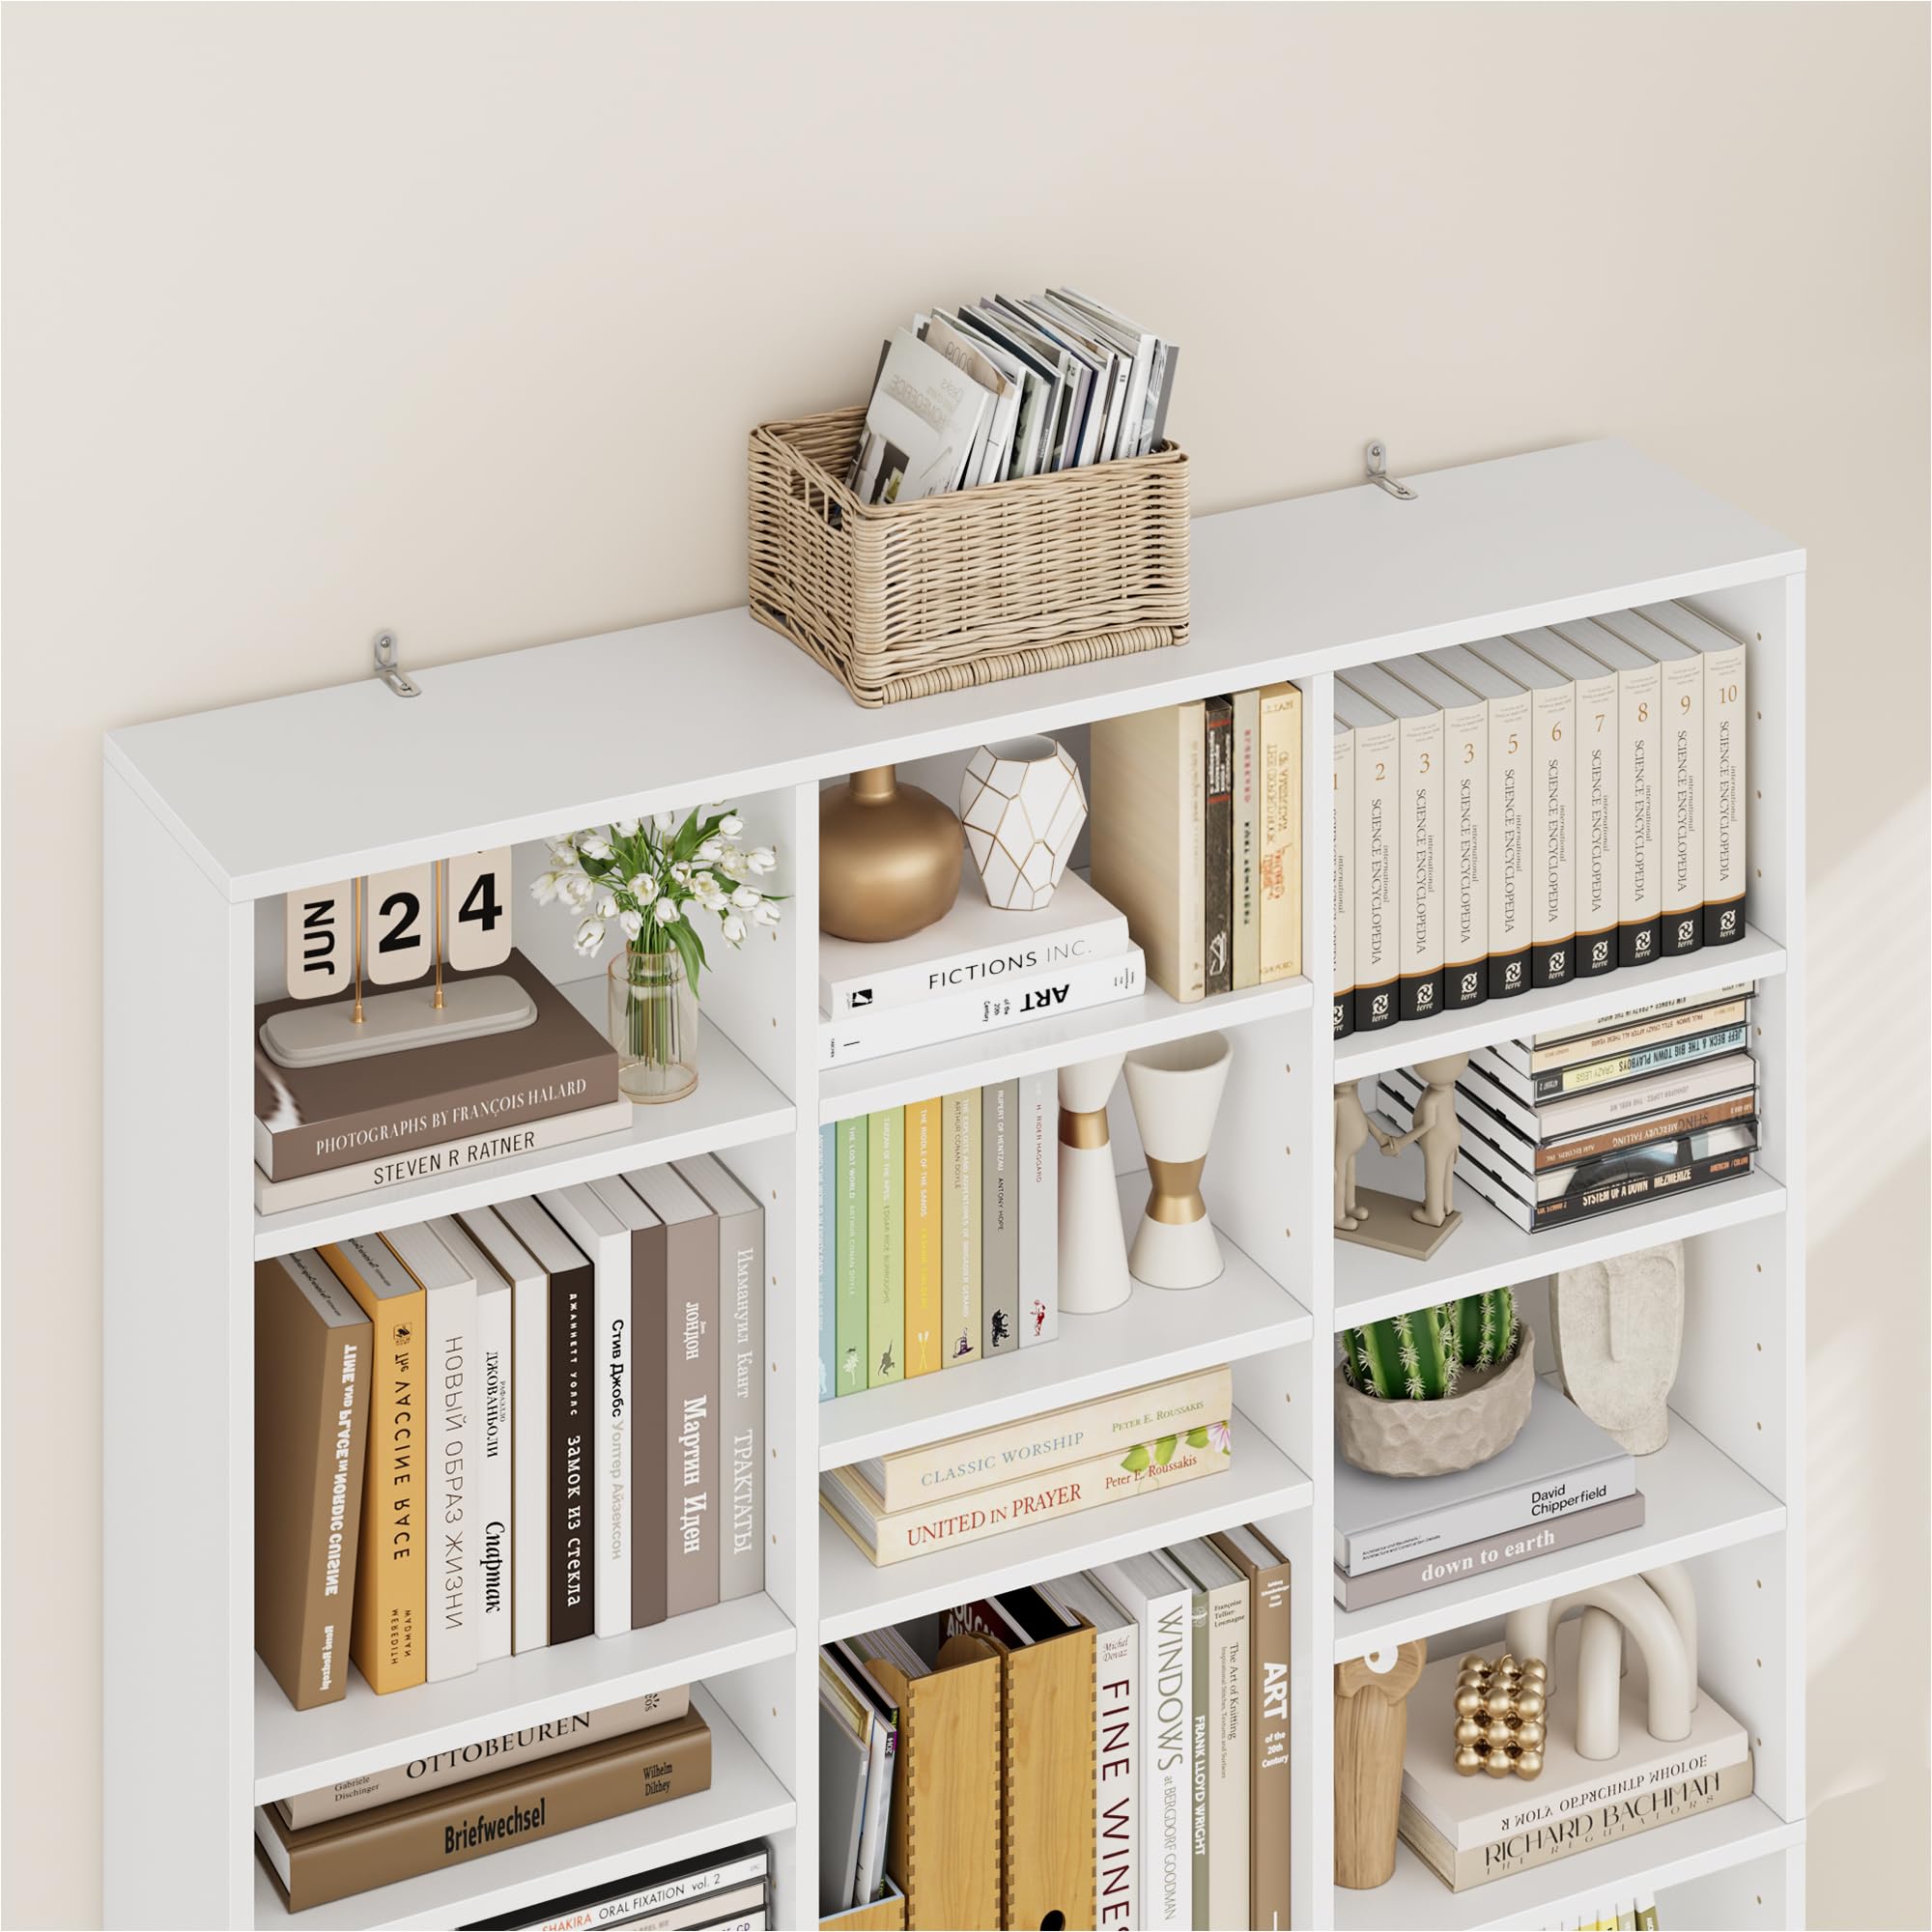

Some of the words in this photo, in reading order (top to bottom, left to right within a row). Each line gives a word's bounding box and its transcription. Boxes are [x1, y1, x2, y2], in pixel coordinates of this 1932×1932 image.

[1637, 702, 1648, 723] 8
[1681, 695, 1691, 716] 9
[1719, 684, 1737, 704] 10
[1508, 733, 1519, 754] 5
[1551, 721, 1562, 742] 6
[1595, 714, 1605, 732] 7
[1719, 721, 1729, 777] SCIENCE
[1376, 763, 1385, 781] 2
[1420, 753, 1431, 774] 3
[1463, 743, 1475, 764] 3
[1591, 750, 1602, 807] SCIENCE
[1634, 740, 1644, 797] SCIENCE
[1677, 730, 1688, 786] SCIENCE
[1461, 779, 1470, 836] SCIENCE
[1504, 769, 1515, 826] SCIENCE
[1548, 759, 1558, 816] SCIENCE
[1372, 799, 1381, 857] SCIENCE
[1416, 788, 1426, 846] SCIENCE
[1677, 790, 1688, 893] ENCYCLOPEDIA
[1719, 781, 1729, 882] ENCYCLOPEDIA
[1548, 820, 1558, 923] ENCYCLOPEDIA
[1591, 810, 1602, 912] ENCYCLOPEDIA
[1634, 800, 1644, 902] ENCYCLOPEDIA
[458, 872, 503, 931] 4
[1416, 850, 1426, 954] ENCYCLOPEDIA
[1461, 839, 1470, 944] ENCYCLOPEDIA
[1504, 830, 1515, 933] ENCYCLOPEDIA
[303, 898, 335, 976] JUN
[378, 893, 422, 954] 2
[1372, 861, 1381, 965] ENCYCLOPEDIA
[929, 952, 1037, 990] FICTIONS
[1046, 940, 1092, 963] INC.
[1020, 983, 1069, 1013] ART
[1654, 1046, 1673, 1062] TOWN
[1674, 1043, 1686, 1056] BIG
[1689, 1039, 1700, 1052] THE
[1710, 1032, 1725, 1046] BECK
[1728, 1028, 1745, 1042] JEFF
[1576, 1069, 1593, 1083] LEGS
[1594, 1065, 1615, 1078] CRAZY
[1618, 1052, 1651, 1072] PLAYBOYS
[316, 1114, 428, 1156] PHOTOGRAPHS
[432, 1110, 450, 1128] BY
[453, 1093, 525, 1122] FRANÇOIS
[527, 1077, 587, 1107] HALARD
[1612, 1130, 1642, 1147] FALLING
[1644, 1122, 1678, 1138] MERCURY
[374, 1150, 441, 1186] STEVEN
[448, 1147, 460, 1167] R
[468, 1130, 535, 1165] RATNER
[734, 1247, 753, 1345] Иммануил
[611, 1319, 624, 1359] Стив
[444, 1336, 467, 1432] НОВЫЙ
[610, 1363, 624, 1418] Джобс
[737, 1349, 753, 1399] Кант
[486, 1351, 498, 1458] ДЖОВАНЬОЛИ
[1112, 1416, 1142, 1434] PETER
[1144, 1413, 1153, 1425] E.
[1156, 1400, 1205, 1422] ROUSSAKIS
[611, 1421, 624, 1479] Уолтер
[679, 1394, 707, 1487] Мартин
[921, 1456, 996, 1488] CLASSIC
[1002, 1432, 1084, 1464] WORSHIP
[444, 1440, 464, 1524] ОБРАЗ
[734, 1429, 753, 1555] ТРАКТАТЫ
[1105, 1472, 1131, 1491] Peter
[1134, 1469, 1145, 1482] E.
[1148, 1454, 1198, 1478] Roussakis
[1531, 1483, 1566, 1503] David
[611, 1483, 624, 1561] Айзексон
[680, 1492, 707, 1553] Иден
[907, 1510, 986, 1548] UNITED
[990, 1507, 1008, 1524] IN
[1011, 1483, 1082, 1519] PRAYER
[1531, 1484, 1607, 1517] Chipperfield
[444, 1530, 464, 1630] ЖИЗНИ
[479, 1520, 505, 1614] Спартак
[1421, 1555, 1474, 1582] down
[1481, 1548, 1498, 1565] to
[1504, 1529, 1555, 1558] earth
[1214, 1600, 1242, 1612] Françoise
[1102, 1649, 1128, 1662] Dovaz
[1103, 1635, 1130, 1654] Michel
[1230, 1642, 1239, 1662] The
[1158, 1605, 1183, 1771] WINDOWS
[1230, 1665, 1238, 1683] Art
[1230, 1685, 1238, 1693] of
[1264, 1662, 1288, 1719] ART
[1102, 1679, 1129, 1781] FINE
[1195, 1715, 1206, 1758] FRANK
[1229, 1695, 1239, 1740] Knitting
[1264, 1733, 1273, 1743] of
[1274, 1731, 1286, 1741] the
[406, 1712, 590, 1779] OTTOBEUREN
[643, 1761, 672, 1781] Wilhelm
[1262, 1754, 1289, 1769] Century
[1267, 1744, 1283, 1755] 20th
[334, 1775, 370, 1793] Gabriele
[334, 1783, 380, 1802] Dischinger
[644, 1778, 670, 1797] Dilthey
[1164, 1776, 1172, 1786] at
[1195, 1759, 1206, 1801] LLOYD
[444, 1798, 546, 1855] Briefwechsel
[1164, 1787, 1177, 1851] BERGDORF
[1195, 1803, 1206, 1856] WRIGHT
[1486, 1814, 1594, 1866] RICHARD
[1603, 1772, 1719, 1828] BACHMAN
[1102, 1797, 1129, 1931] WINE
[1164, 1853, 1177, 1921] GOODMAN
[598, 1903, 630, 1920] ORAL
[633, 1884, 685, 1910] FIXATION
[692, 1876, 709, 1891] vol.
[714, 1873, 721, 1885] 2
